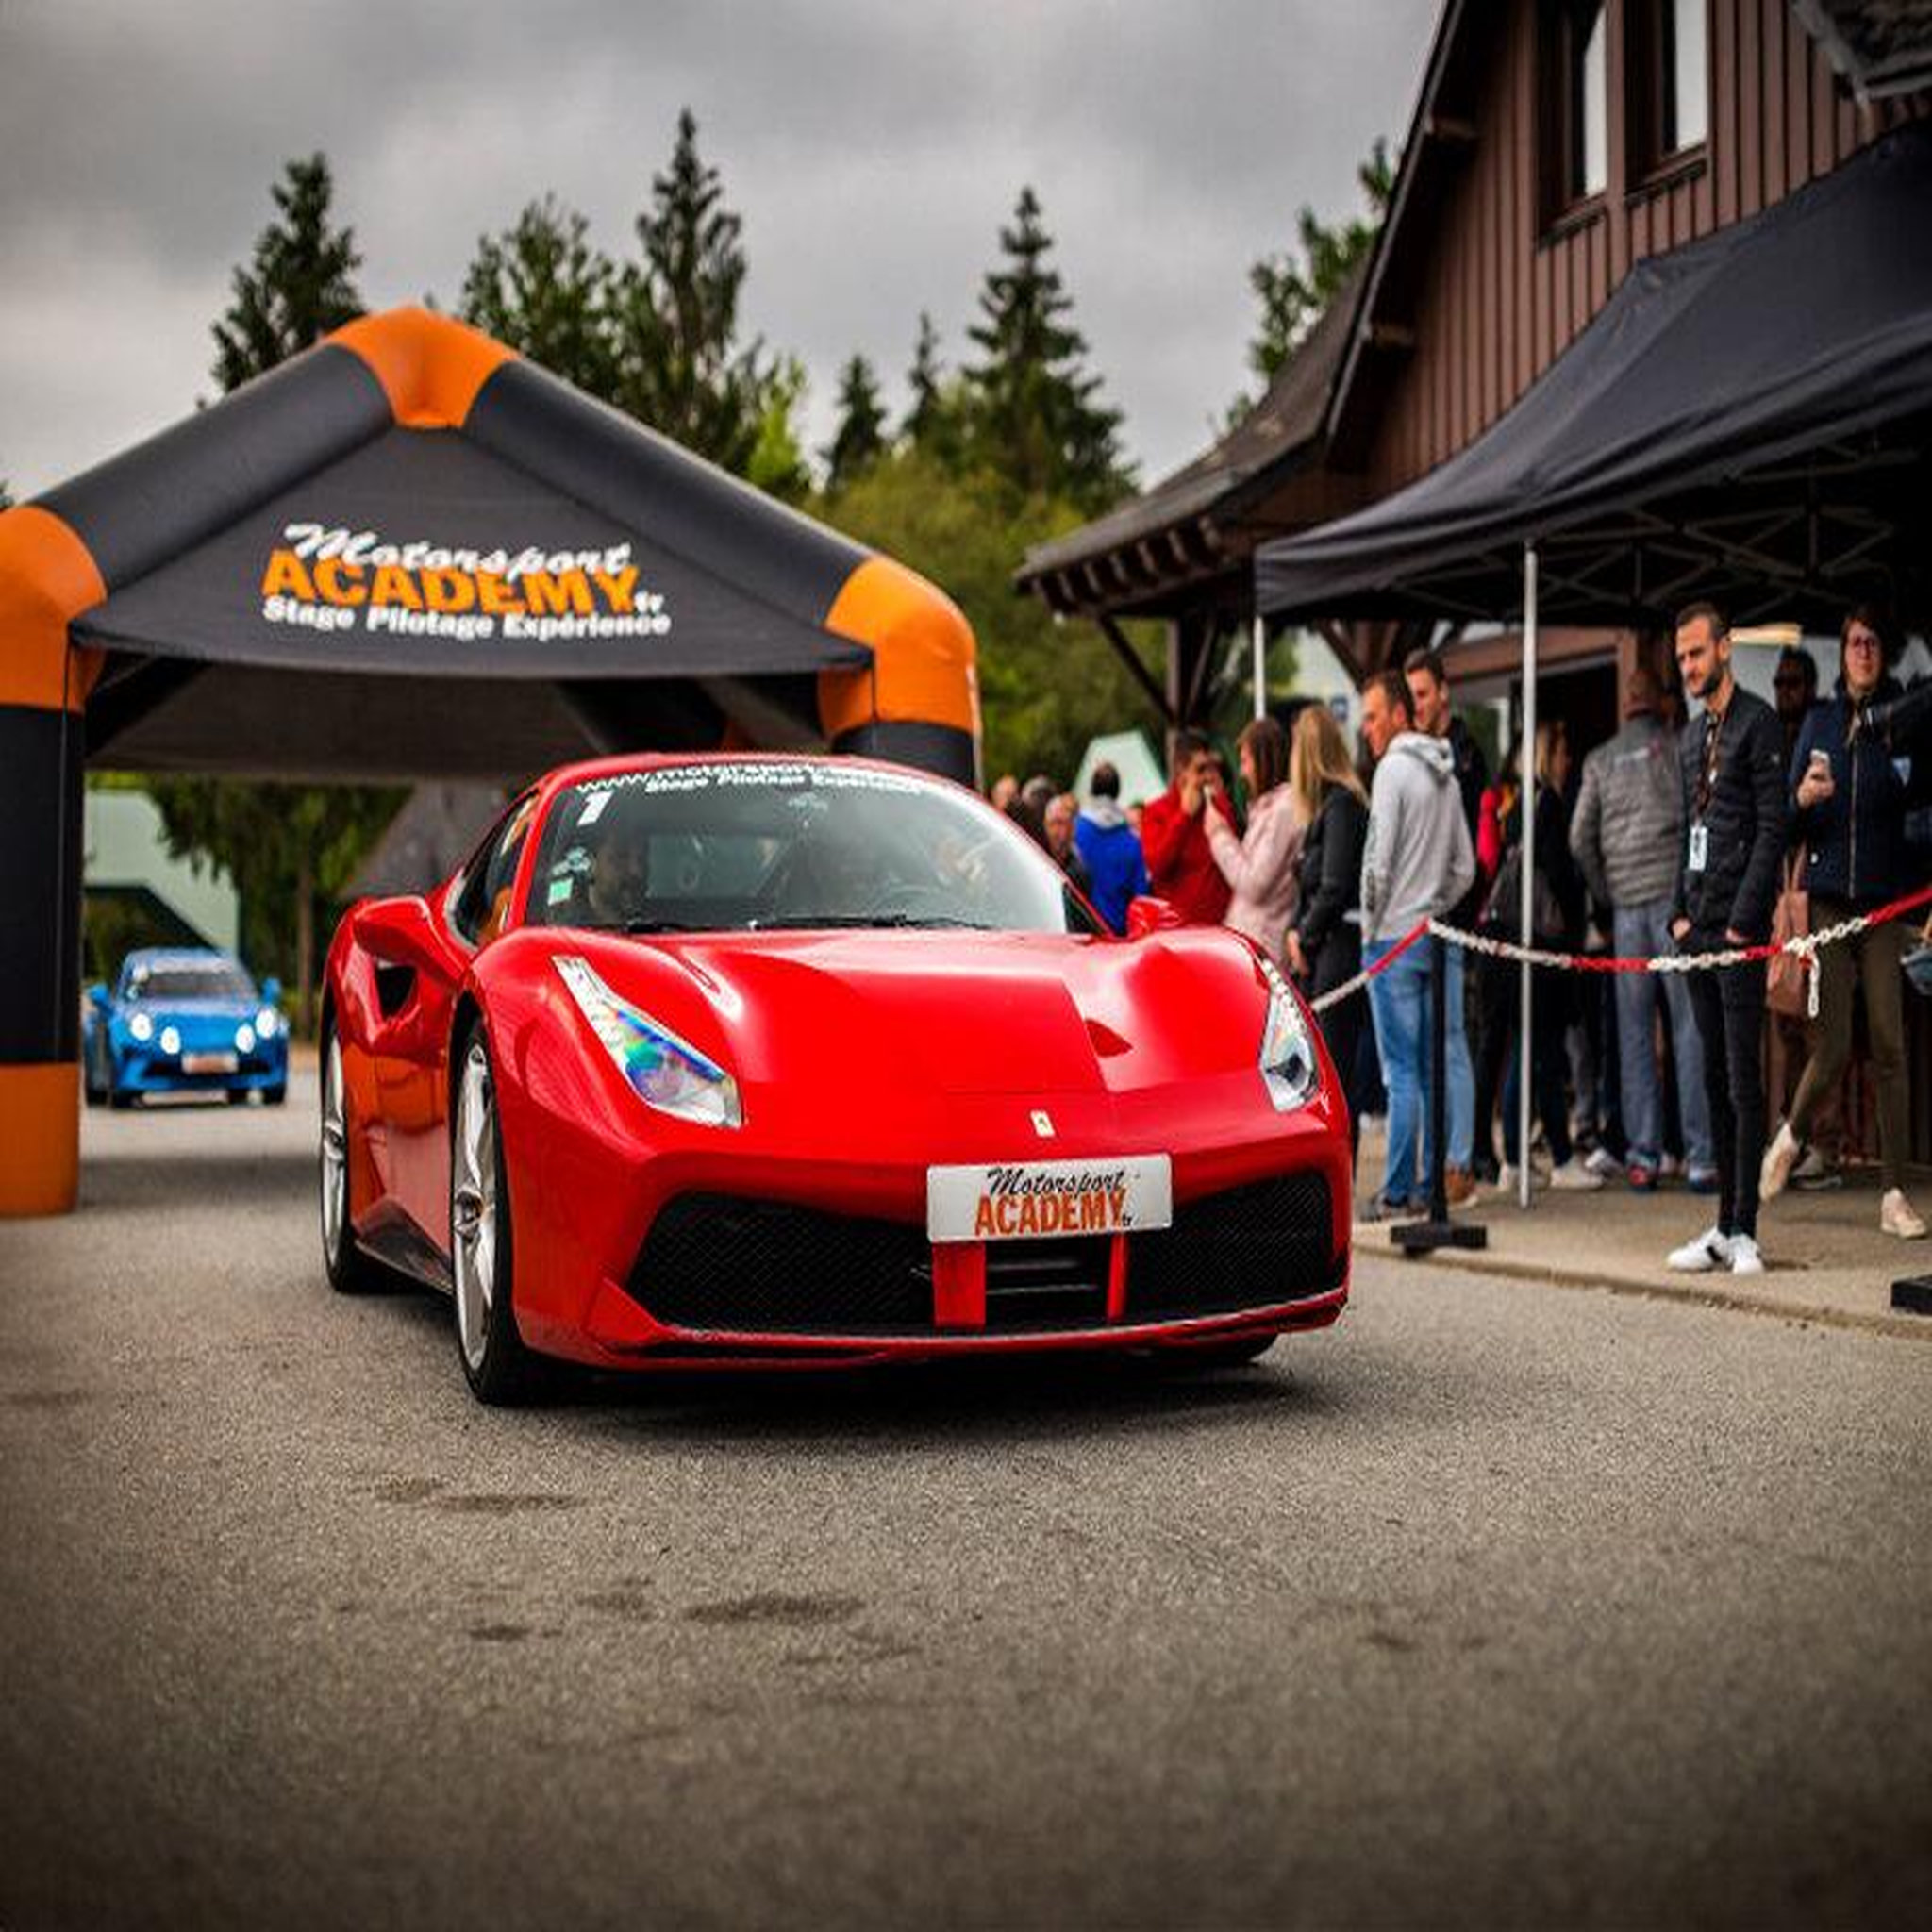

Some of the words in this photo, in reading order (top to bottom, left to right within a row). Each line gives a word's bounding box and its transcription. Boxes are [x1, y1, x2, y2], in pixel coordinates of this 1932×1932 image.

[285, 524, 631, 583] Motorsport
[261, 548, 639, 617] ACADEMY
[263, 596, 356, 631] Stage
[365, 606, 495, 641] Pilotage
[577, 791, 613, 826] 1
[988, 1167, 1124, 1200] Motorsport
[975, 1187, 1127, 1236] ACADEMY
